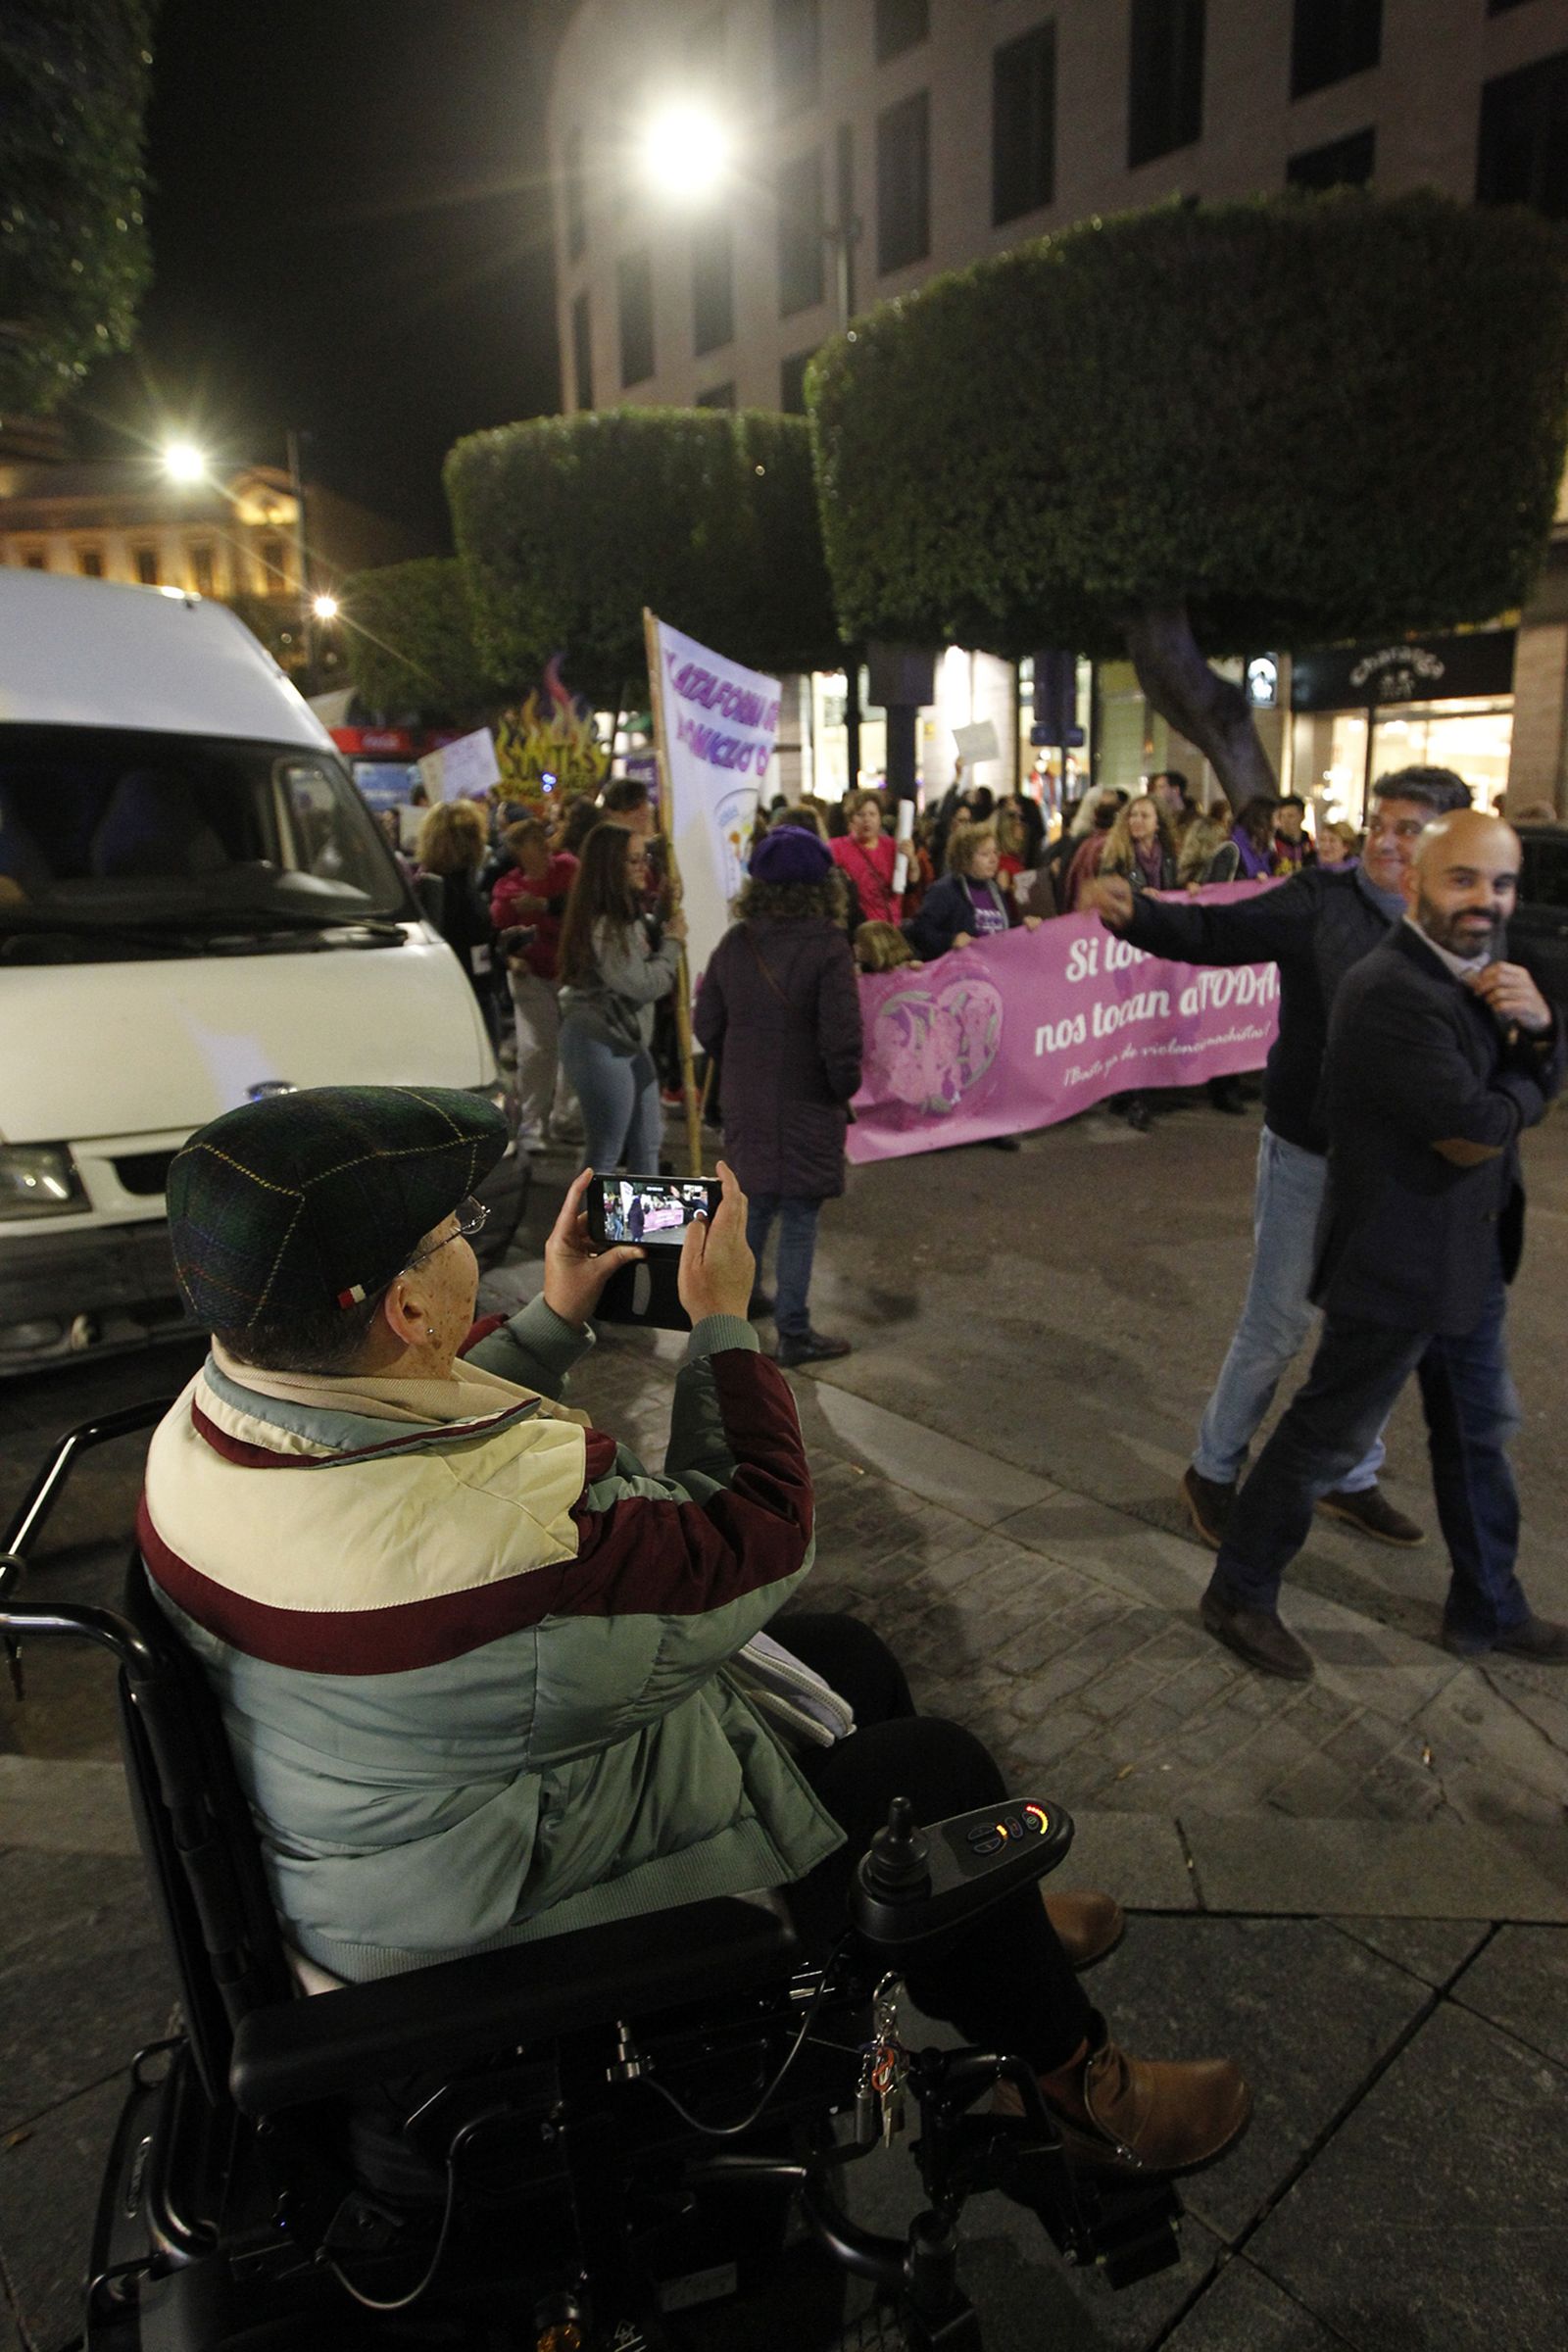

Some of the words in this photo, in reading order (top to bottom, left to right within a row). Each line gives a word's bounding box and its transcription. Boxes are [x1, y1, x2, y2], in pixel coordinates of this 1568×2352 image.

[1066, 937, 1099, 983] Si
[1035, 1012, 1087, 1056] nos
[1092, 989, 1171, 1039] tocan
